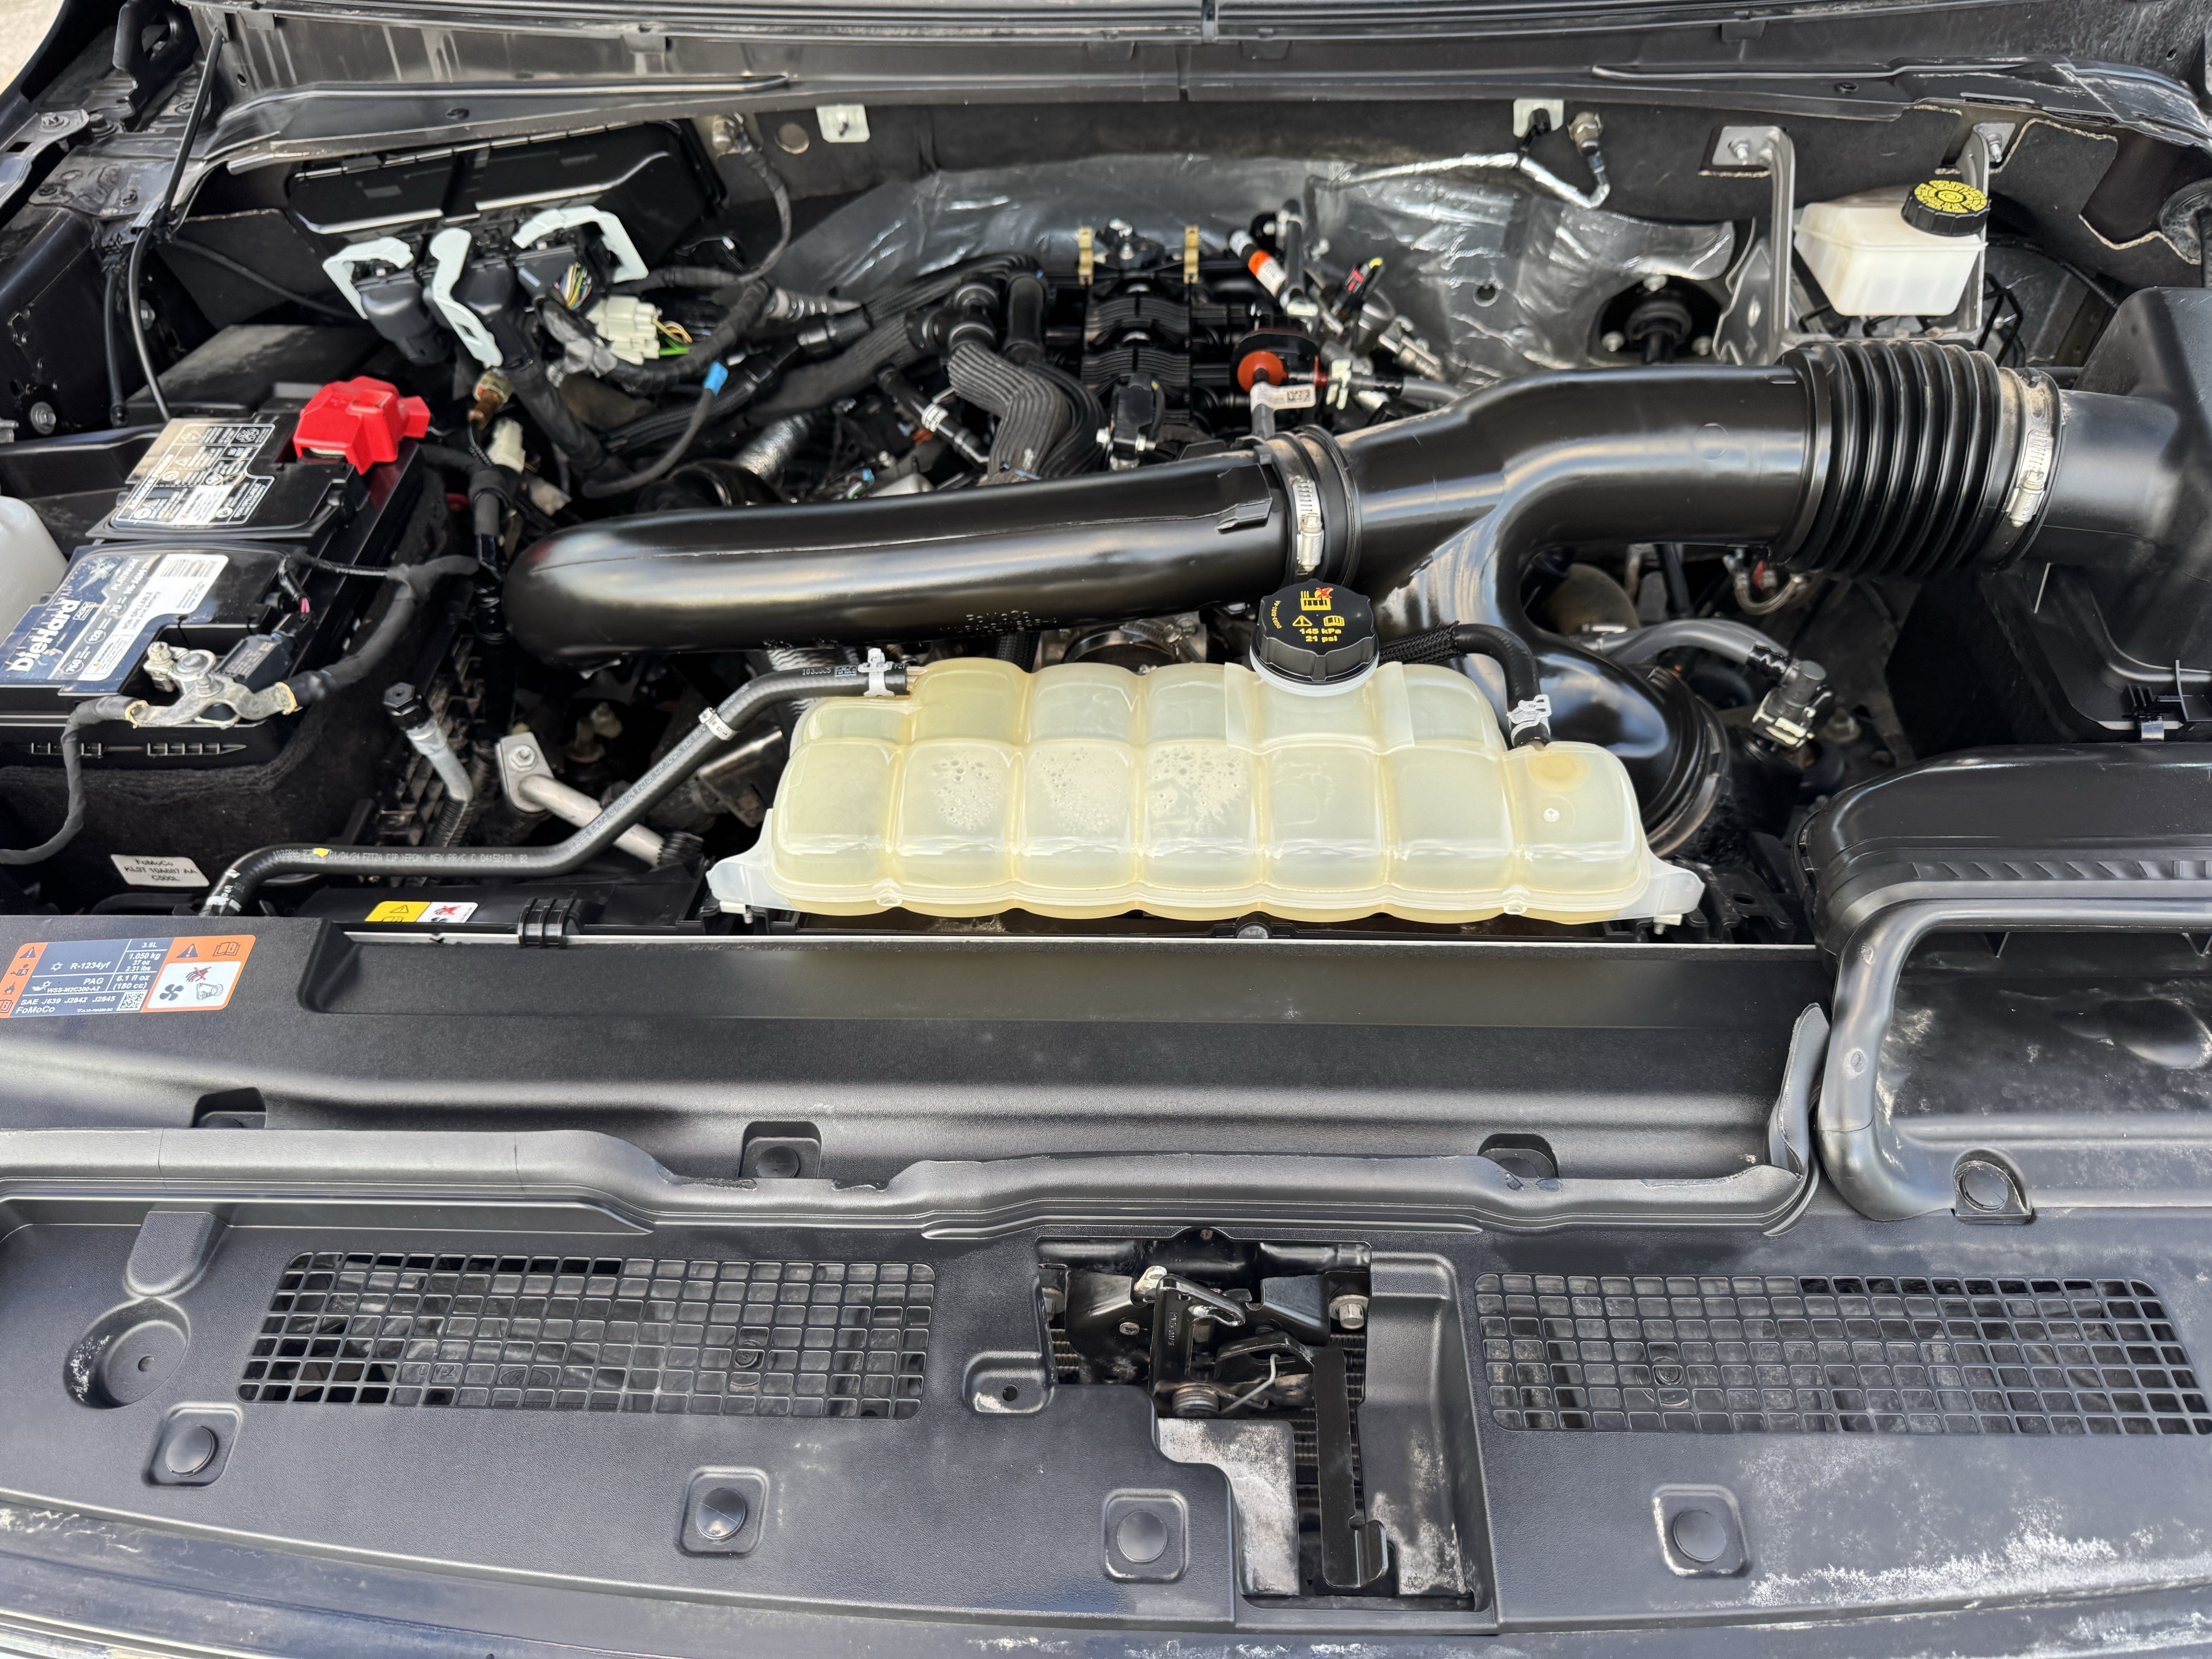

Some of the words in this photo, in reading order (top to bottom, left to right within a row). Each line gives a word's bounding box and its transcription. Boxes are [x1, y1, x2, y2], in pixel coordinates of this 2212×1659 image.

[7, 599, 81, 672] DieHard
[65, 659, 82, 673] 760
[386, 853, 399, 862] CIP
[135, 859, 174, 867] FoMoCo
[150, 952, 161, 960] kg
[70, 961, 112, 971] R-1234yf
[84, 977, 104, 986] PAG
[113, 982, 132, 991] (180
[15, 1005, 56, 1014] FoMoCo
